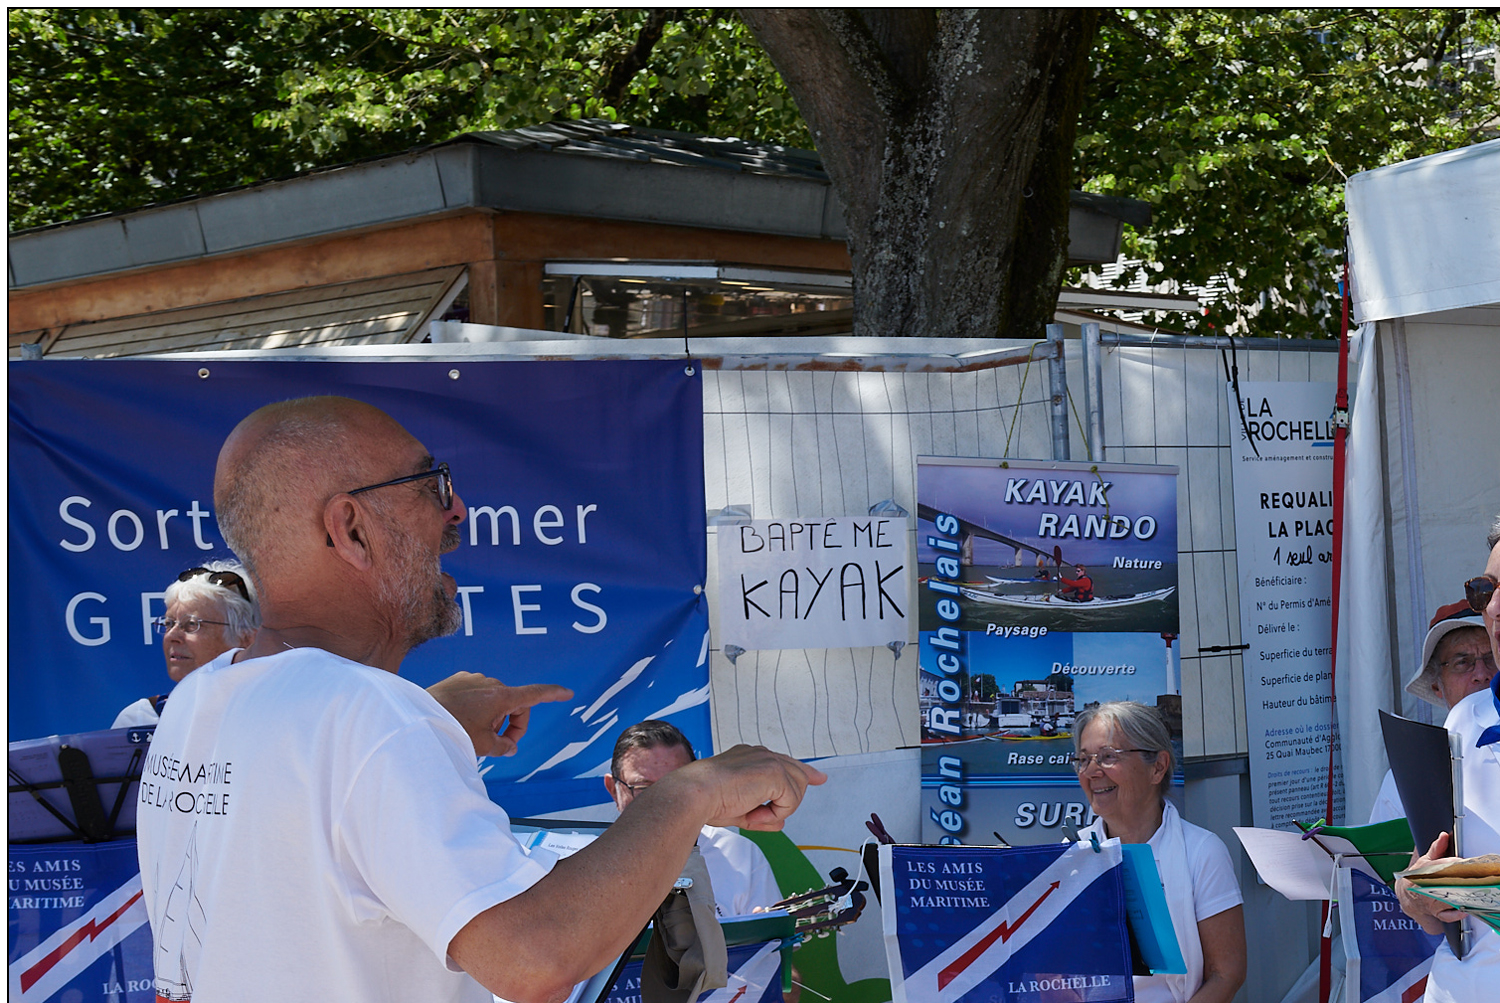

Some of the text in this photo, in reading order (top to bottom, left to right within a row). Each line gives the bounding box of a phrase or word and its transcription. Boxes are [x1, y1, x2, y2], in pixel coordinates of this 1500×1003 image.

[1247, 397, 1273, 418] LA
[1242, 455, 1263, 463] Service
[1264, 453, 1304, 463] aménagement
[1004, 478, 1111, 506] KAYAK
[468, 504, 598, 546] mer
[1038, 513, 1157, 539] RANDO
[1268, 521, 1289, 538] LA
[1286, 545, 1313, 566] seul
[1113, 556, 1163, 570] Nature
[1255, 575, 1303, 587] Bénéficiaire
[741, 560, 905, 621] KAYAK
[1268, 600, 1279, 610] du
[1280, 598, 1306, 610] Permis
[928, 513, 963, 737] Rochelais
[986, 623, 1048, 637] Paysage
[1257, 622, 1295, 634] Délivré le
[1260, 648, 1300, 662] Superficie
[1302, 646, 1313, 657] du
[1051, 662, 1136, 676] Découverte
[1261, 673, 1302, 687] Superficie
[1303, 671, 1314, 682] de
[1262, 698, 1295, 710] Hauteur
[1297, 696, 1308, 707] du
[1265, 727, 1293, 737] Adresse
[1305, 724, 1313, 732] le
[1265, 735, 1313, 749] Communauté
[1007, 752, 1075, 765] Rase cai
[1266, 751, 1274, 760] 25
[1275, 748, 1293, 758] Quai
[1295, 745, 1323, 757] Maubec
[142, 781, 154, 805] DE
[32, 859, 82, 873] AMIS
[907, 860, 984, 874] LES AMIS
[25, 874, 84, 891] MUSÉE
[909, 877, 986, 892] DU MUSÉE
[910, 896, 990, 909] MARITIME
[1372, 901, 1394, 912] DU
[102, 981, 125, 995] LA
[1008, 974, 1112, 994] LA ROCHELLE
